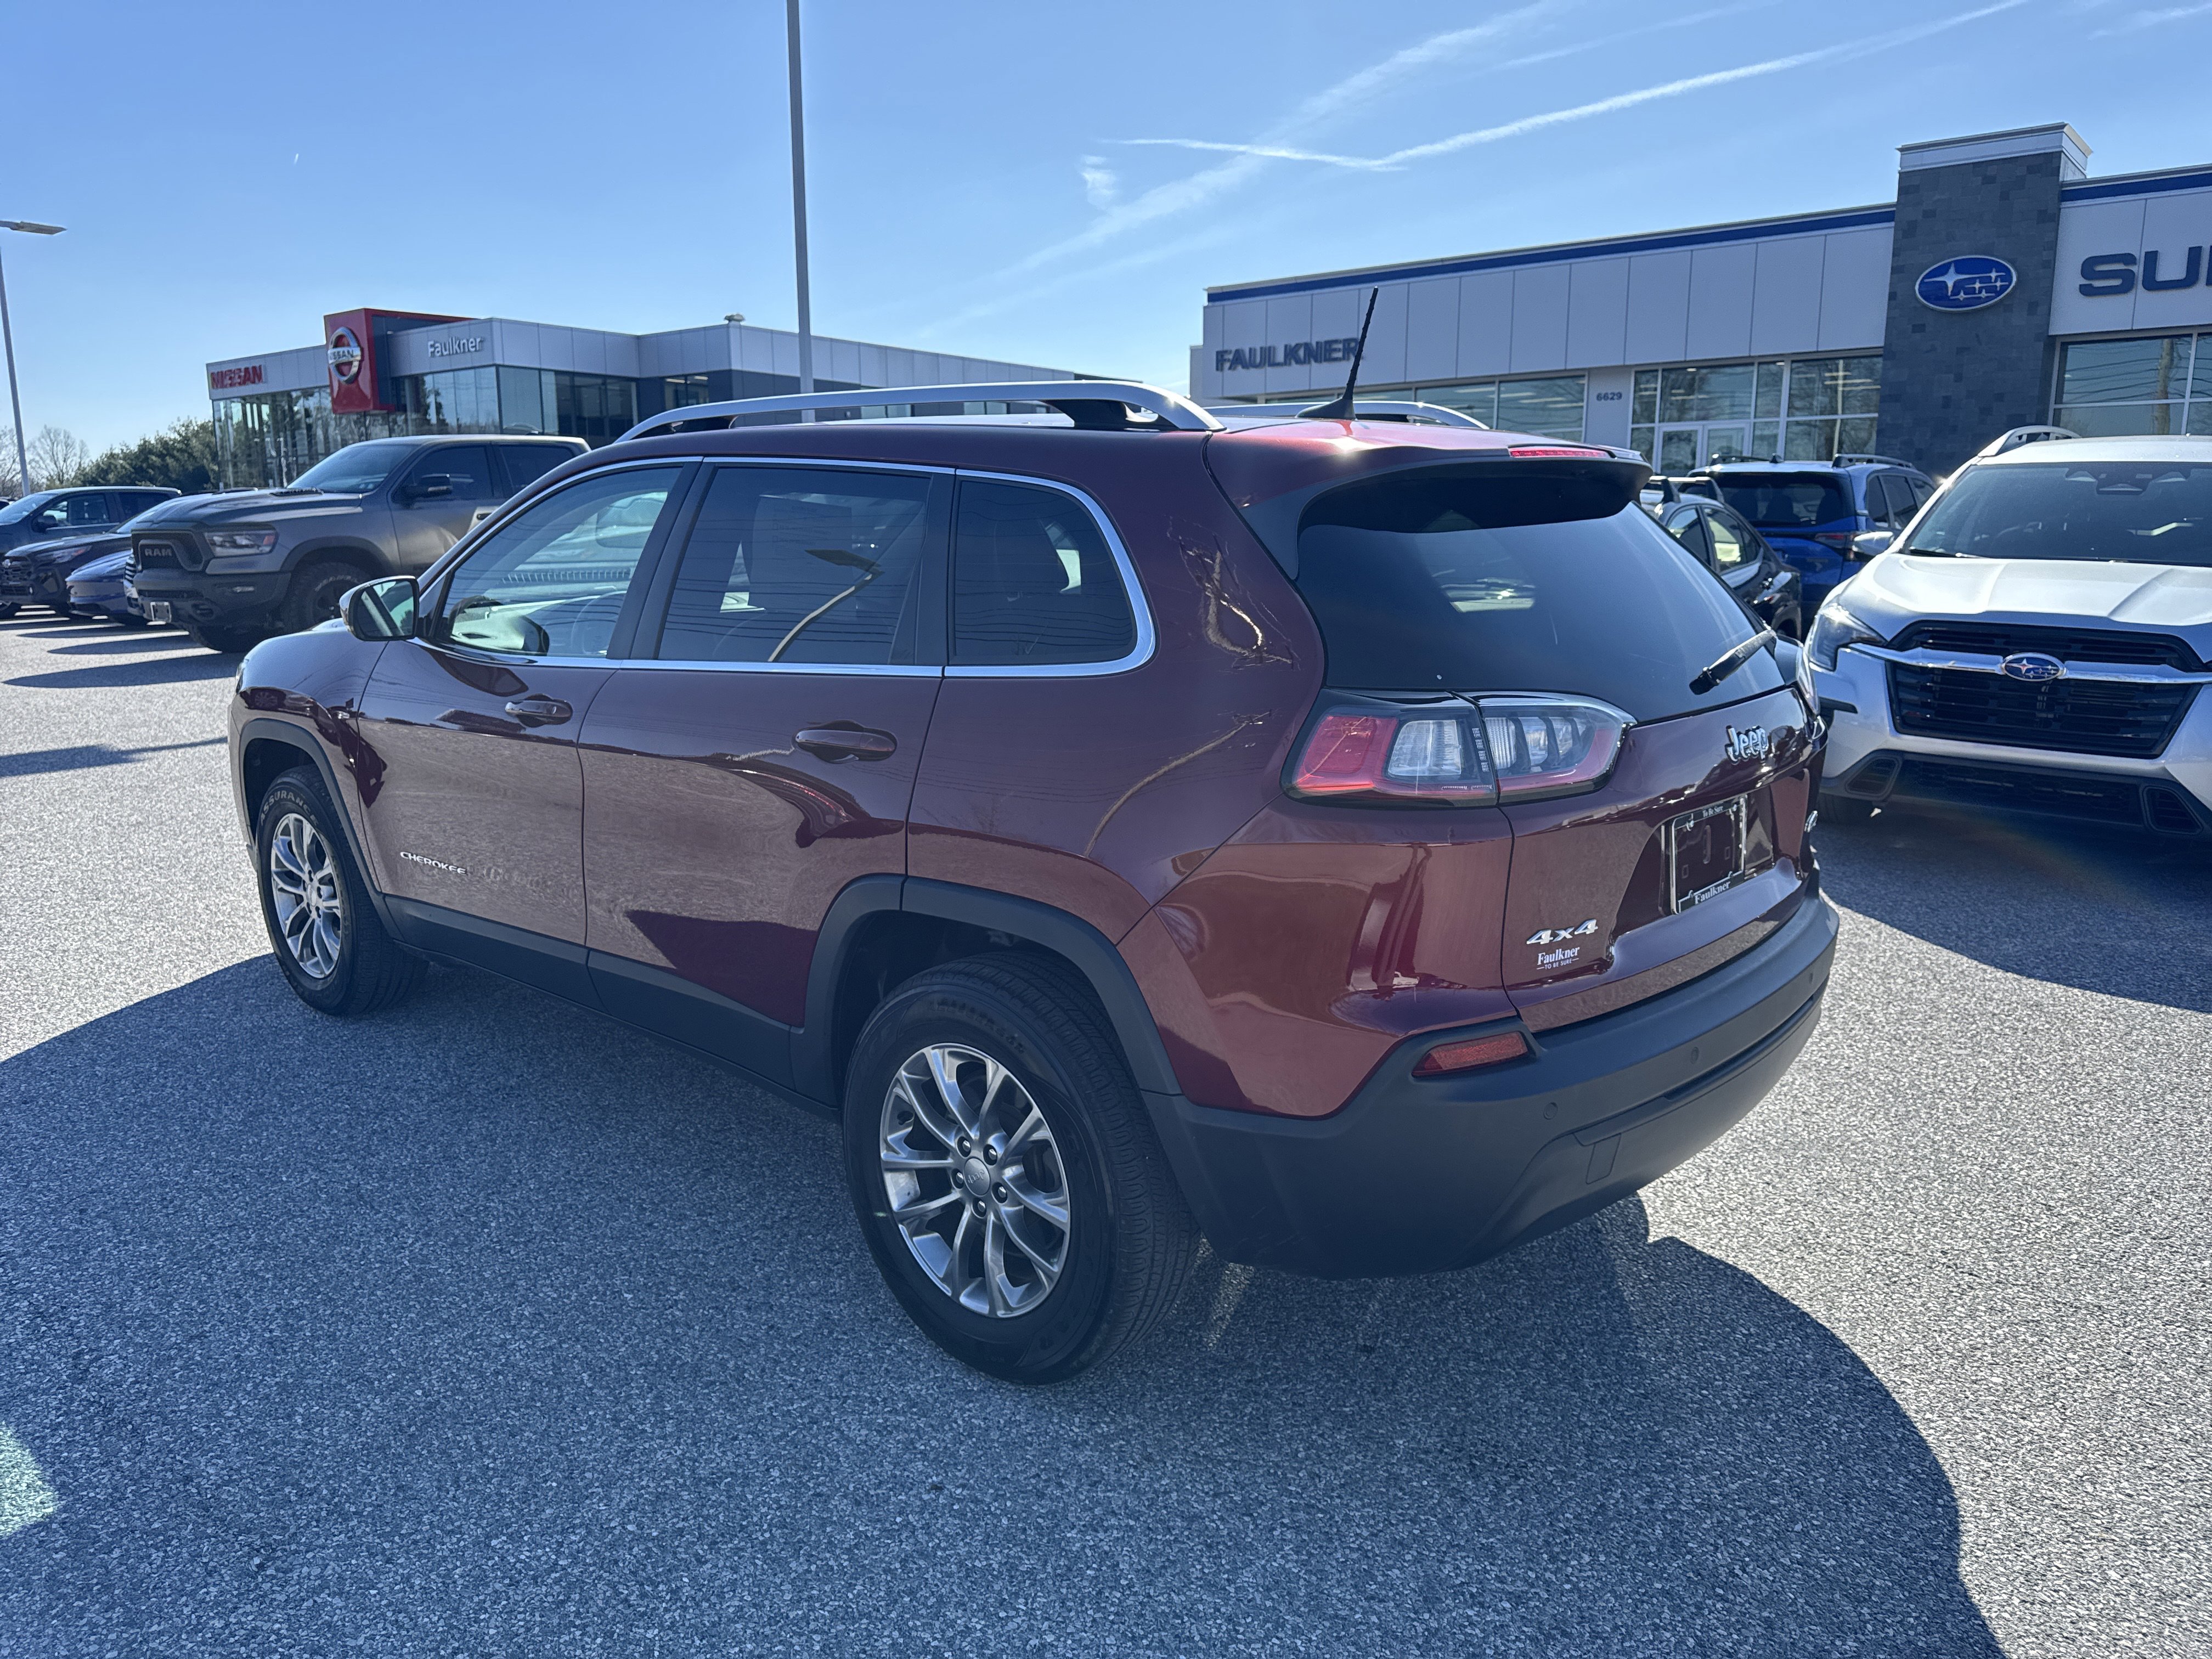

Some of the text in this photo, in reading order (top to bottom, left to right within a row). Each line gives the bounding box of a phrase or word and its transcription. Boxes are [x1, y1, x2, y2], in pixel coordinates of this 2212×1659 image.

[2079, 246, 2212, 296] SU
[428, 336, 482, 357] Faulkner
[1216, 337, 1363, 371] FAULKNER
[211, 365, 262, 389] NISSAN
[1596, 392, 1622, 401] 6629
[1725, 726, 1769, 762] Jeep
[261, 790, 317, 826] ASSURANCE
[400, 851, 467, 875] CHEROKEE
[1695, 882, 1730, 904] Faulkner
[1526, 918, 1598, 944] 4x4
[1537, 947, 1580, 965] Faulkner
